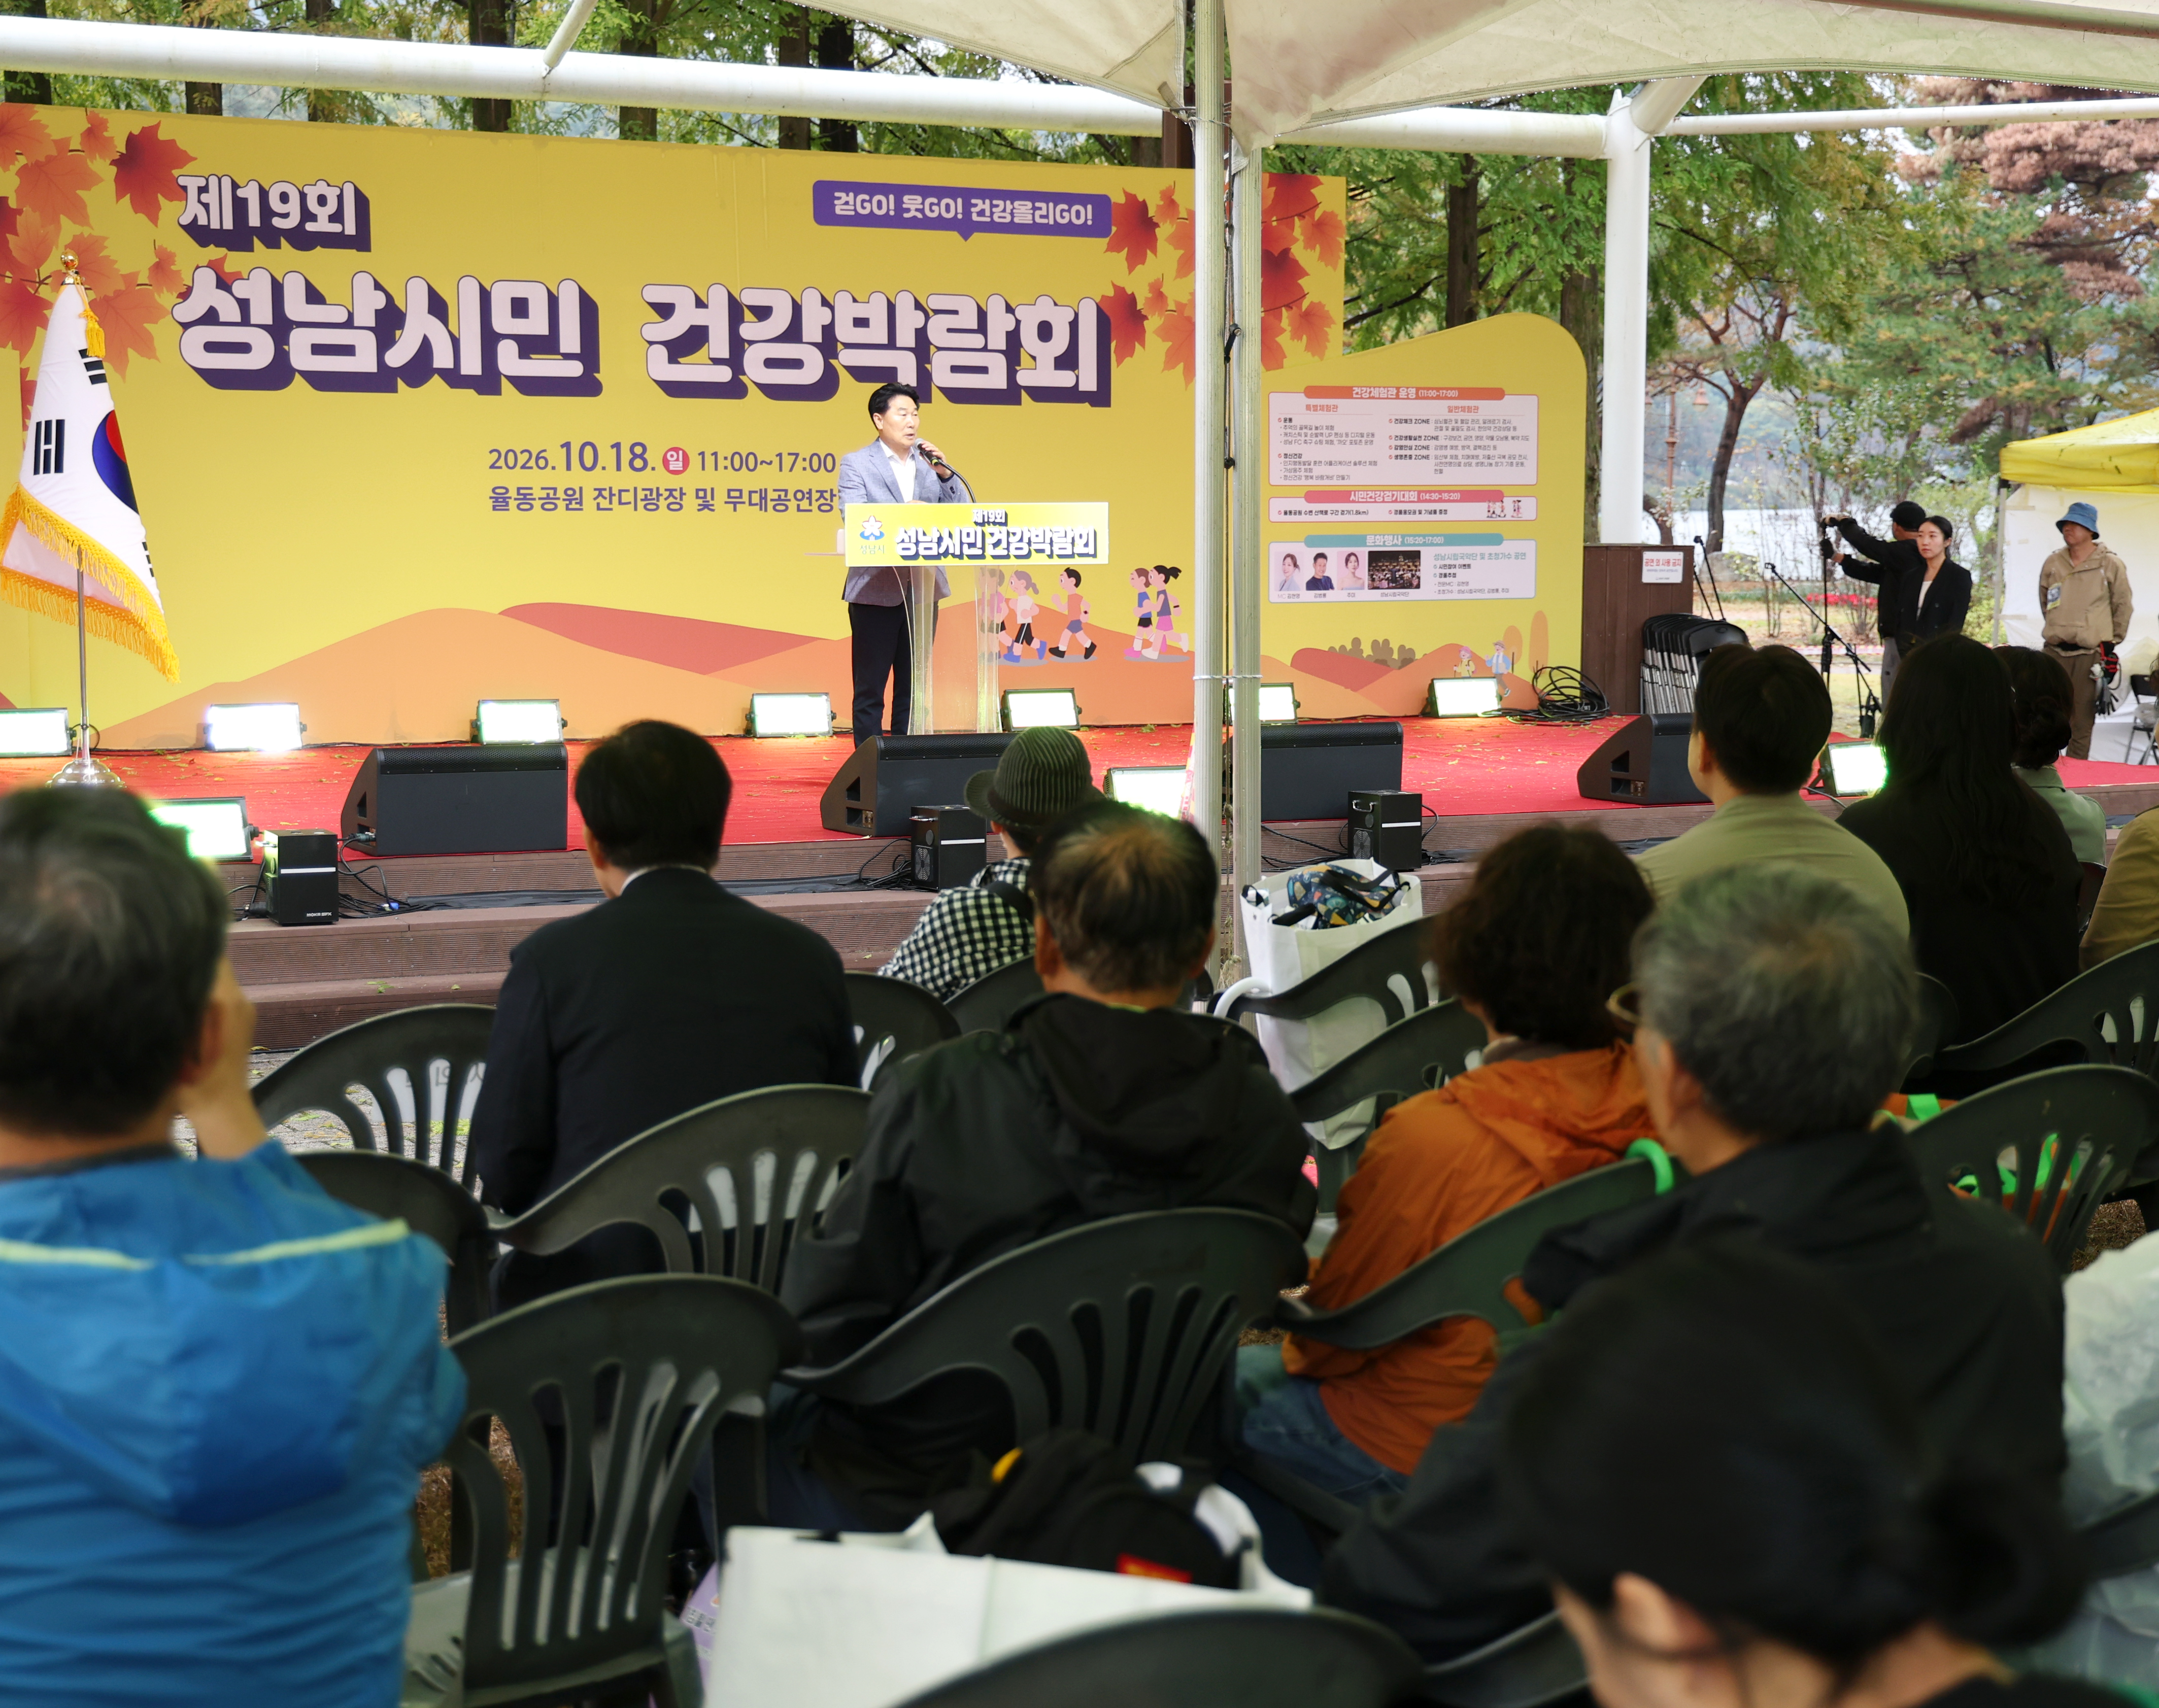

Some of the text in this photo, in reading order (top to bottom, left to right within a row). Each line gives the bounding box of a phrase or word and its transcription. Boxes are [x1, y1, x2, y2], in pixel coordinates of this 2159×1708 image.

[176, 174, 357, 236] 제19회
[834, 191, 1093, 225] 걷GO! 웃GO! 건강올리GO!
[172, 266, 1098, 392] 성남시민 건강박람회
[1352, 387, 1396, 398] 건강체험관
[1399, 387, 1416, 398] 운영
[489, 441, 836, 473] 2026.10.18. 일 11:00~17:00
[488, 486, 837, 513] 율동공원 잔디광장 및 무대공연장
[1350, 491, 1418, 502] 시민건강걷기대회
[972, 508, 1005, 523] 제19회
[859, 544, 885, 555] 성남시
[895, 526, 1095, 556] 성남시민 건강박람회
[1366, 534, 1402, 545] 문화행사
